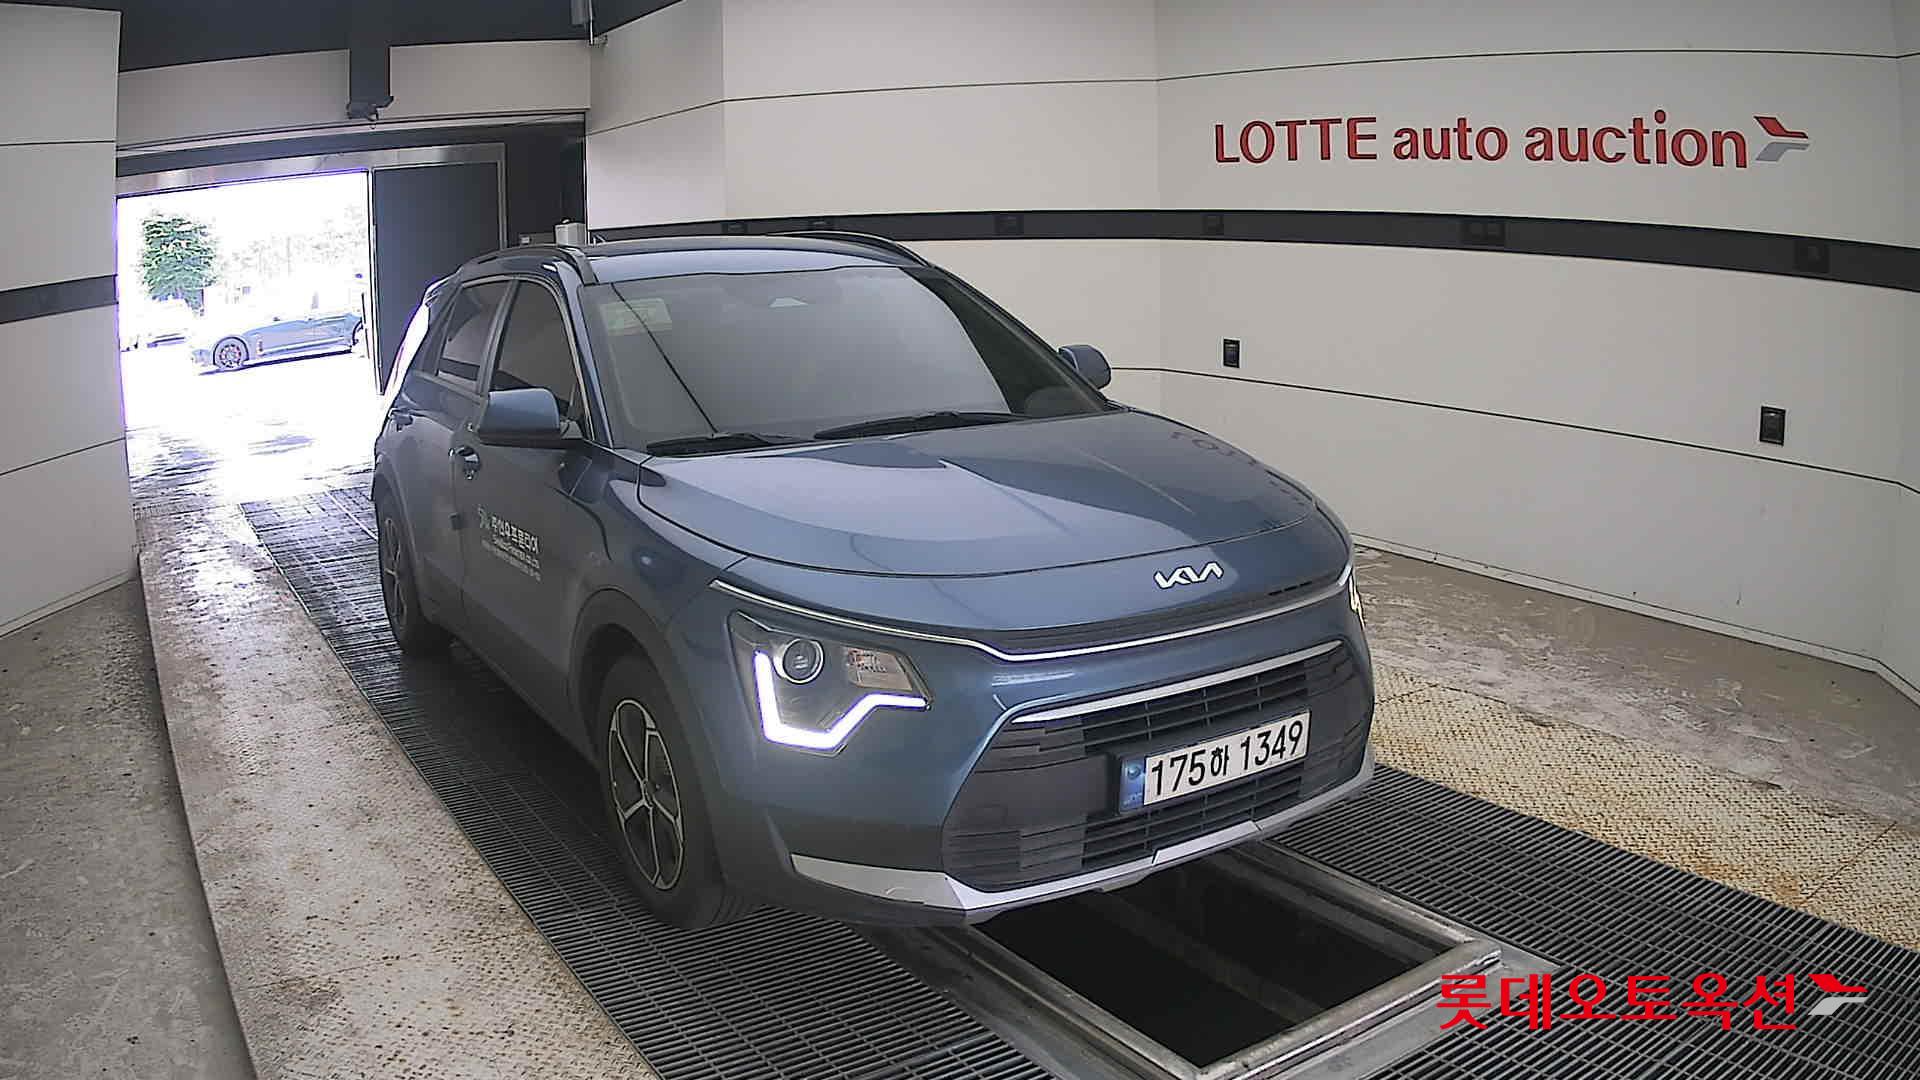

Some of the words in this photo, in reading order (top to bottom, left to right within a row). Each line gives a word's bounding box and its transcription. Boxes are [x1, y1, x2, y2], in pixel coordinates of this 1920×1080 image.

[1214, 116, 1378, 164] LOTTE
[1391, 117, 1509, 161] auto
[1523, 110, 1749, 169] auction
[1153, 561, 1224, 589] KIA
[1151, 745, 1229, 796] 175하
[1240, 720, 1304, 771] 1349
